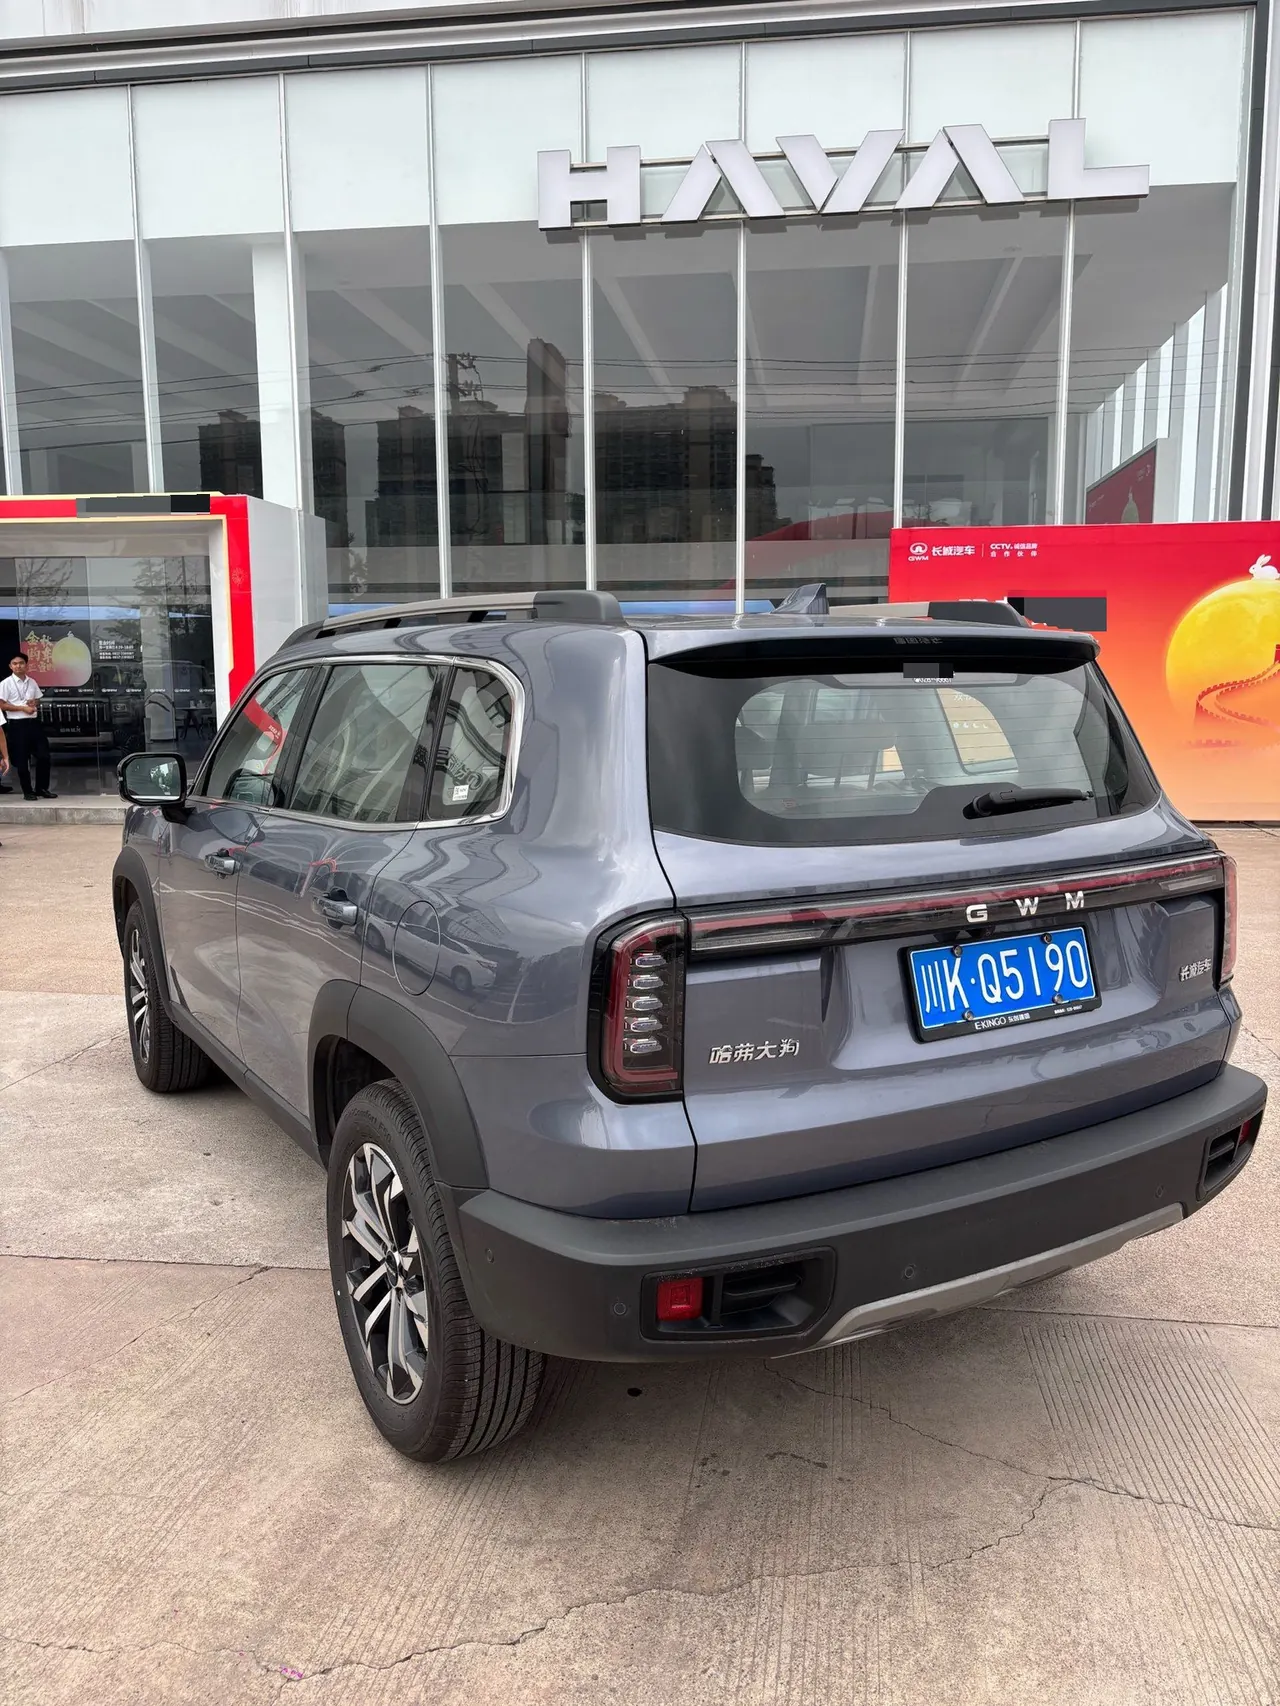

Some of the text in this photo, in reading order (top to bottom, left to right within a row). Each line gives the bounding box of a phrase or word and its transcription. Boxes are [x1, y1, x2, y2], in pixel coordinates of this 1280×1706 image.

[537, 117, 1150, 231] HAVAL
[931, 545, 975, 557] 长城汽车
[966, 891, 1085, 923] GWM
[920, 940, 1088, 1014] 川K·Q5190
[1180, 958, 1212, 982] 长城汽车
[708, 1038, 800, 1064] 哈弗大狗
